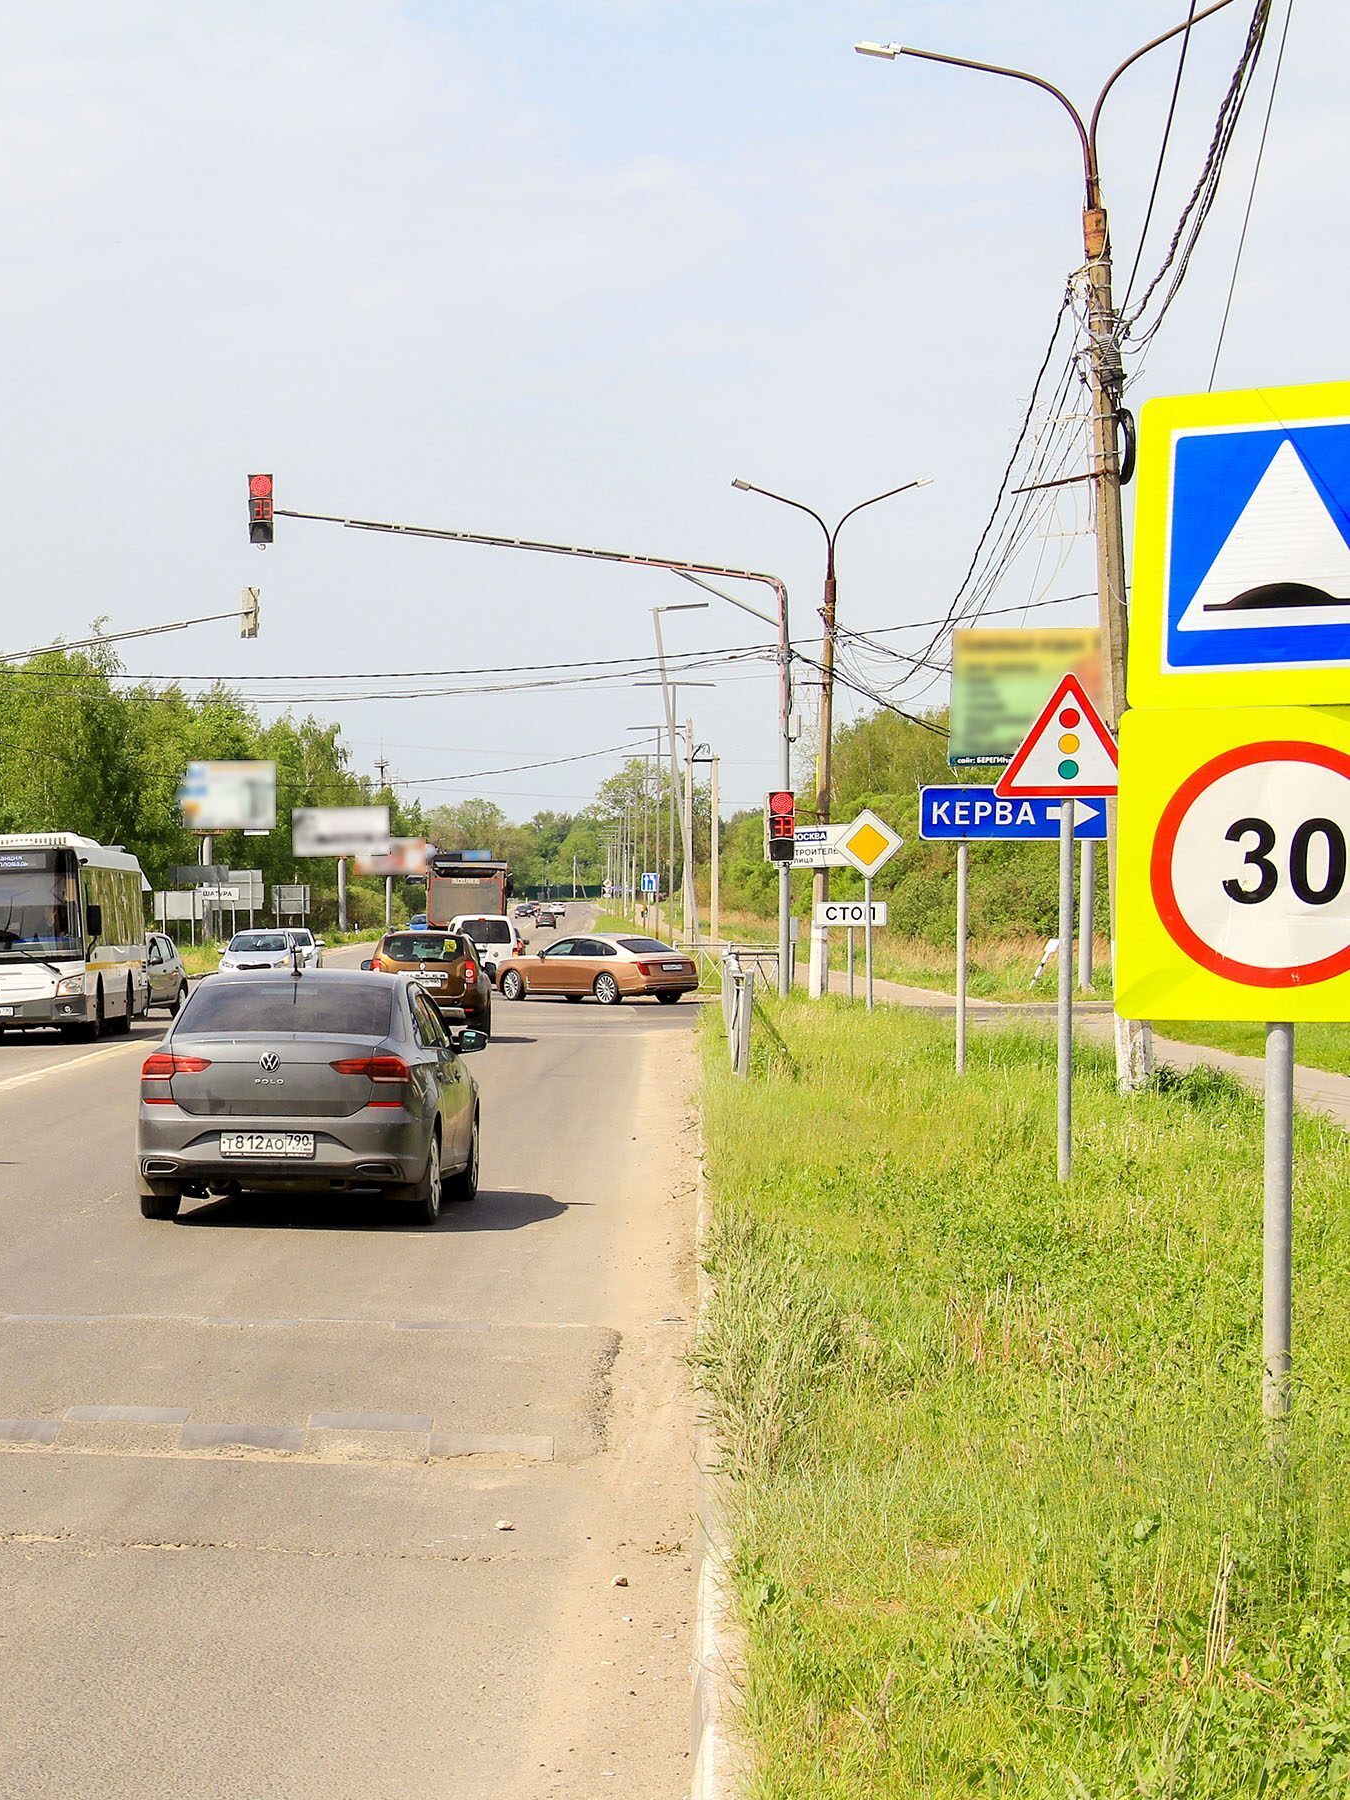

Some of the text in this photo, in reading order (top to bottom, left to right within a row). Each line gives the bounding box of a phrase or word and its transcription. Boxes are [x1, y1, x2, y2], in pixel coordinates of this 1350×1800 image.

[254, 499, 272, 519] 33
[931, 801, 1036, 825] КЕРВА
[773, 817, 794, 837] 33
[794, 831, 826, 842] ОСКВА
[1223, 817, 1347, 906] 30
[286, 1134, 310, 1147] 790
